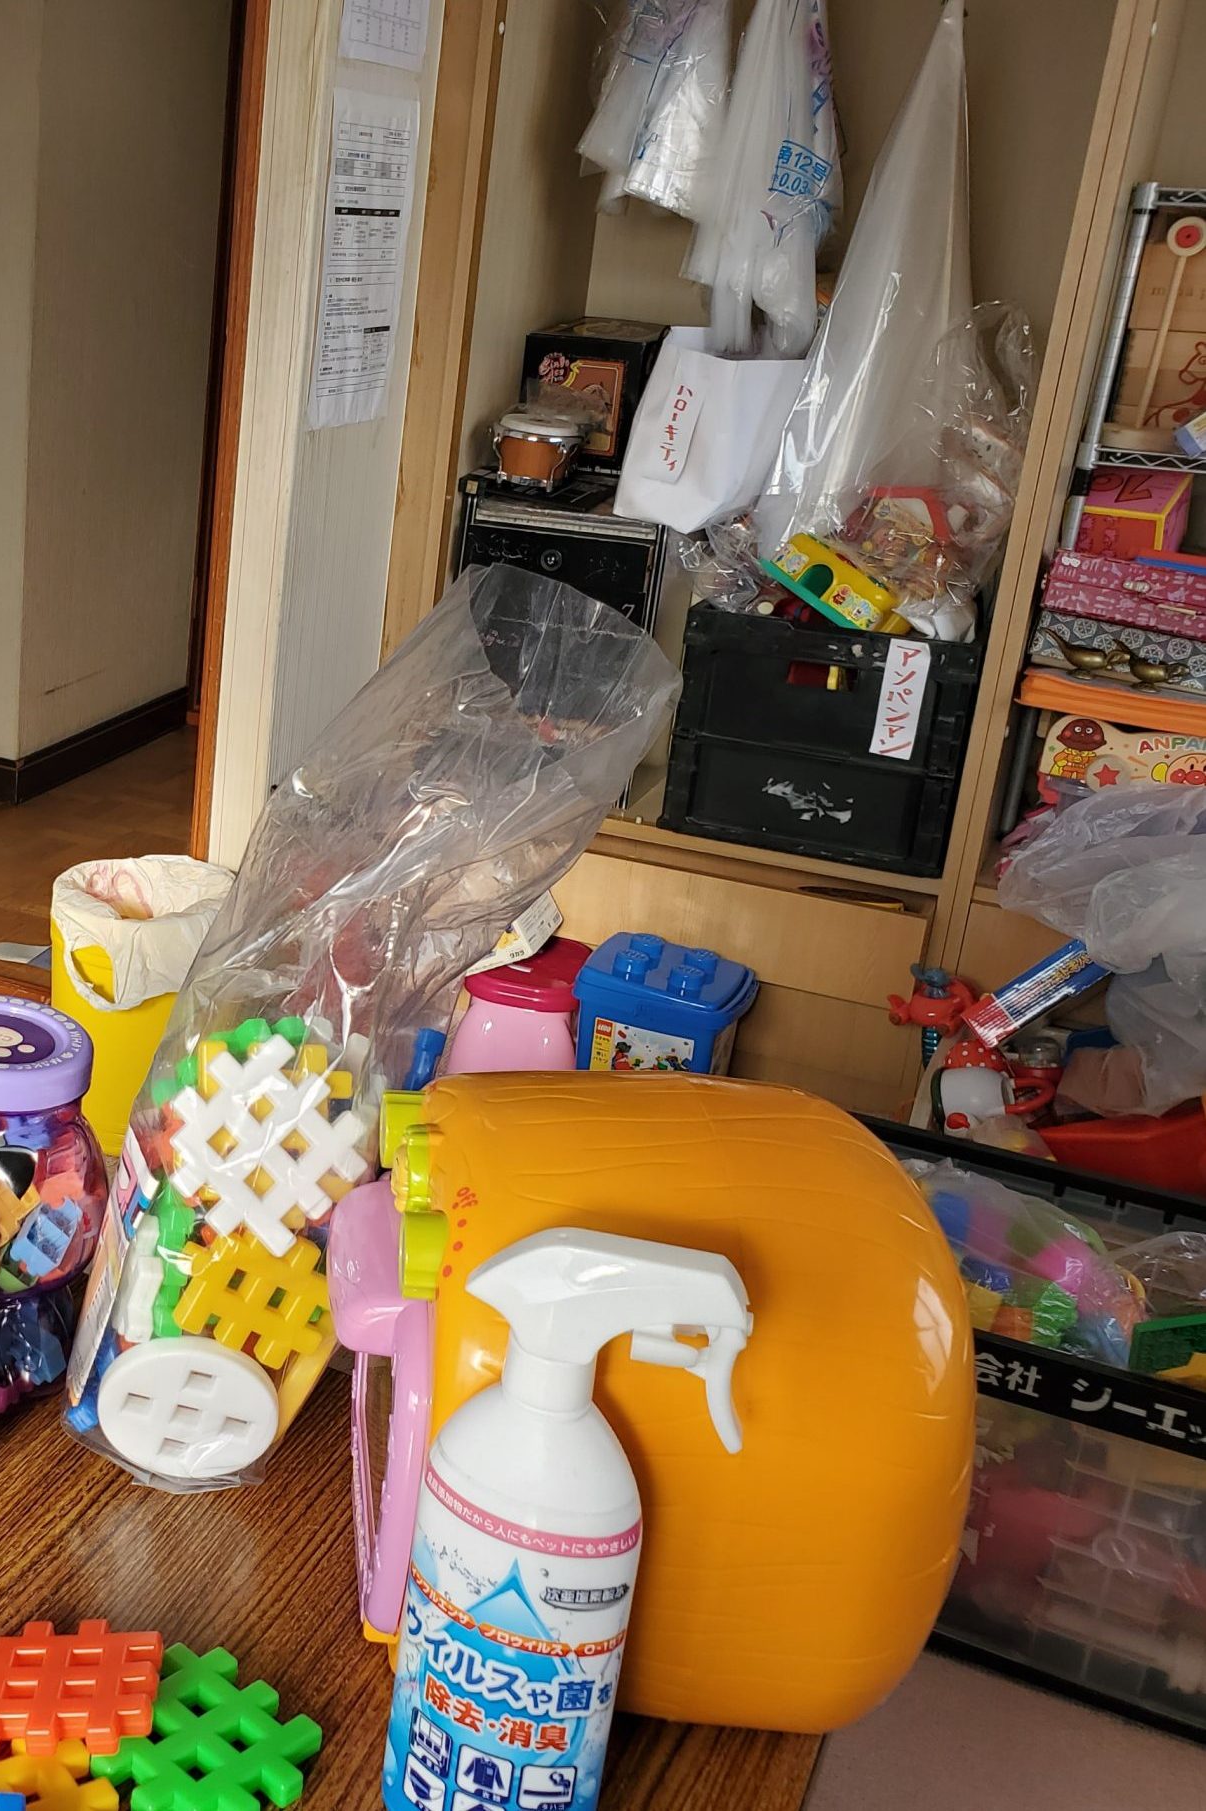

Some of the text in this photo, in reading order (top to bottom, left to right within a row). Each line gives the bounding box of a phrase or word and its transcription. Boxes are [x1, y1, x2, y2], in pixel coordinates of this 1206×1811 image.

[660, 385, 693, 471] ハローキティ
[879, 645, 922, 754] アンパンマン
[974, 1352, 1042, 1398] 会社
[483, 1628, 564, 1656] ノロウイルス
[424, 1672, 569, 1751] 除去・消臭
